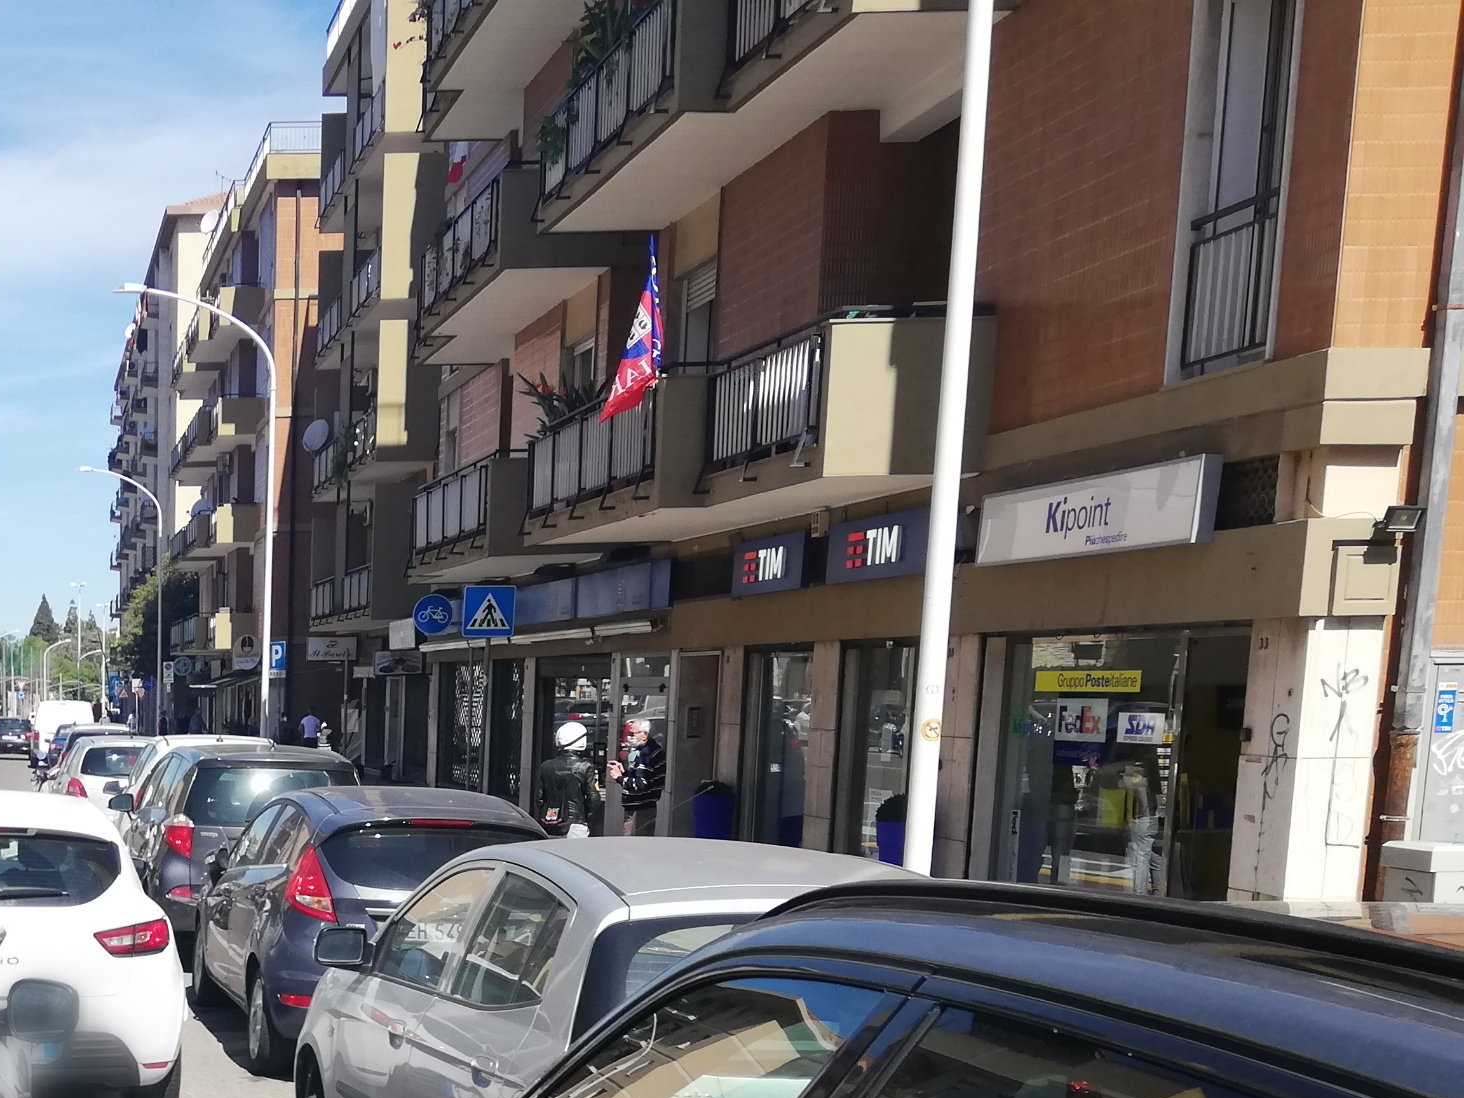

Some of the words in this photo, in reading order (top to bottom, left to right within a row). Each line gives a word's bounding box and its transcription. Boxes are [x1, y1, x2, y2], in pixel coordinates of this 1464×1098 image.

[1045, 495, 1112, 540] Kipoint
[866, 525, 901, 566] TIM
[758, 546, 785, 581] TIM
[271, 645, 283, 667] P
[1058, 705, 1102, 735] FedEx
[1124, 714, 1156, 735] SDA
